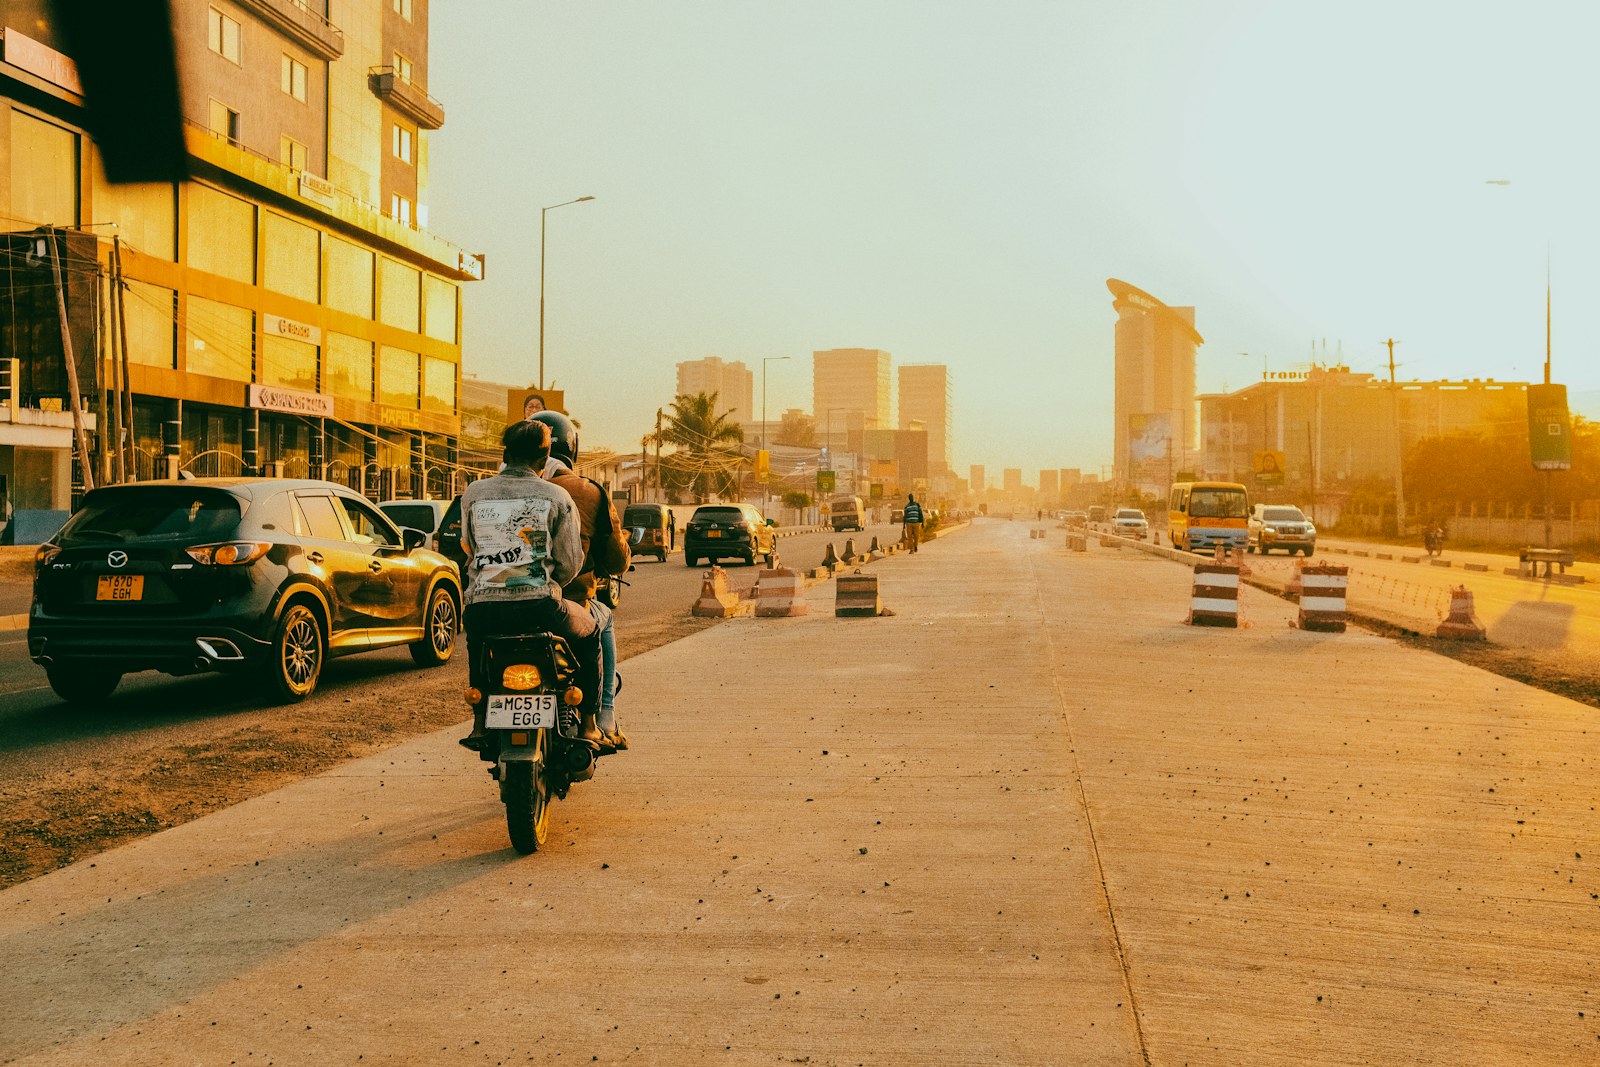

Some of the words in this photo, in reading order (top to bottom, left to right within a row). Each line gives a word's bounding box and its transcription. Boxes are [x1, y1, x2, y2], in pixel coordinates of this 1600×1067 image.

[107, 575, 133, 588] T670
[112, 588, 131, 600] EGH
[504, 697, 552, 711] MC515
[512, 712, 541, 726] EGG
